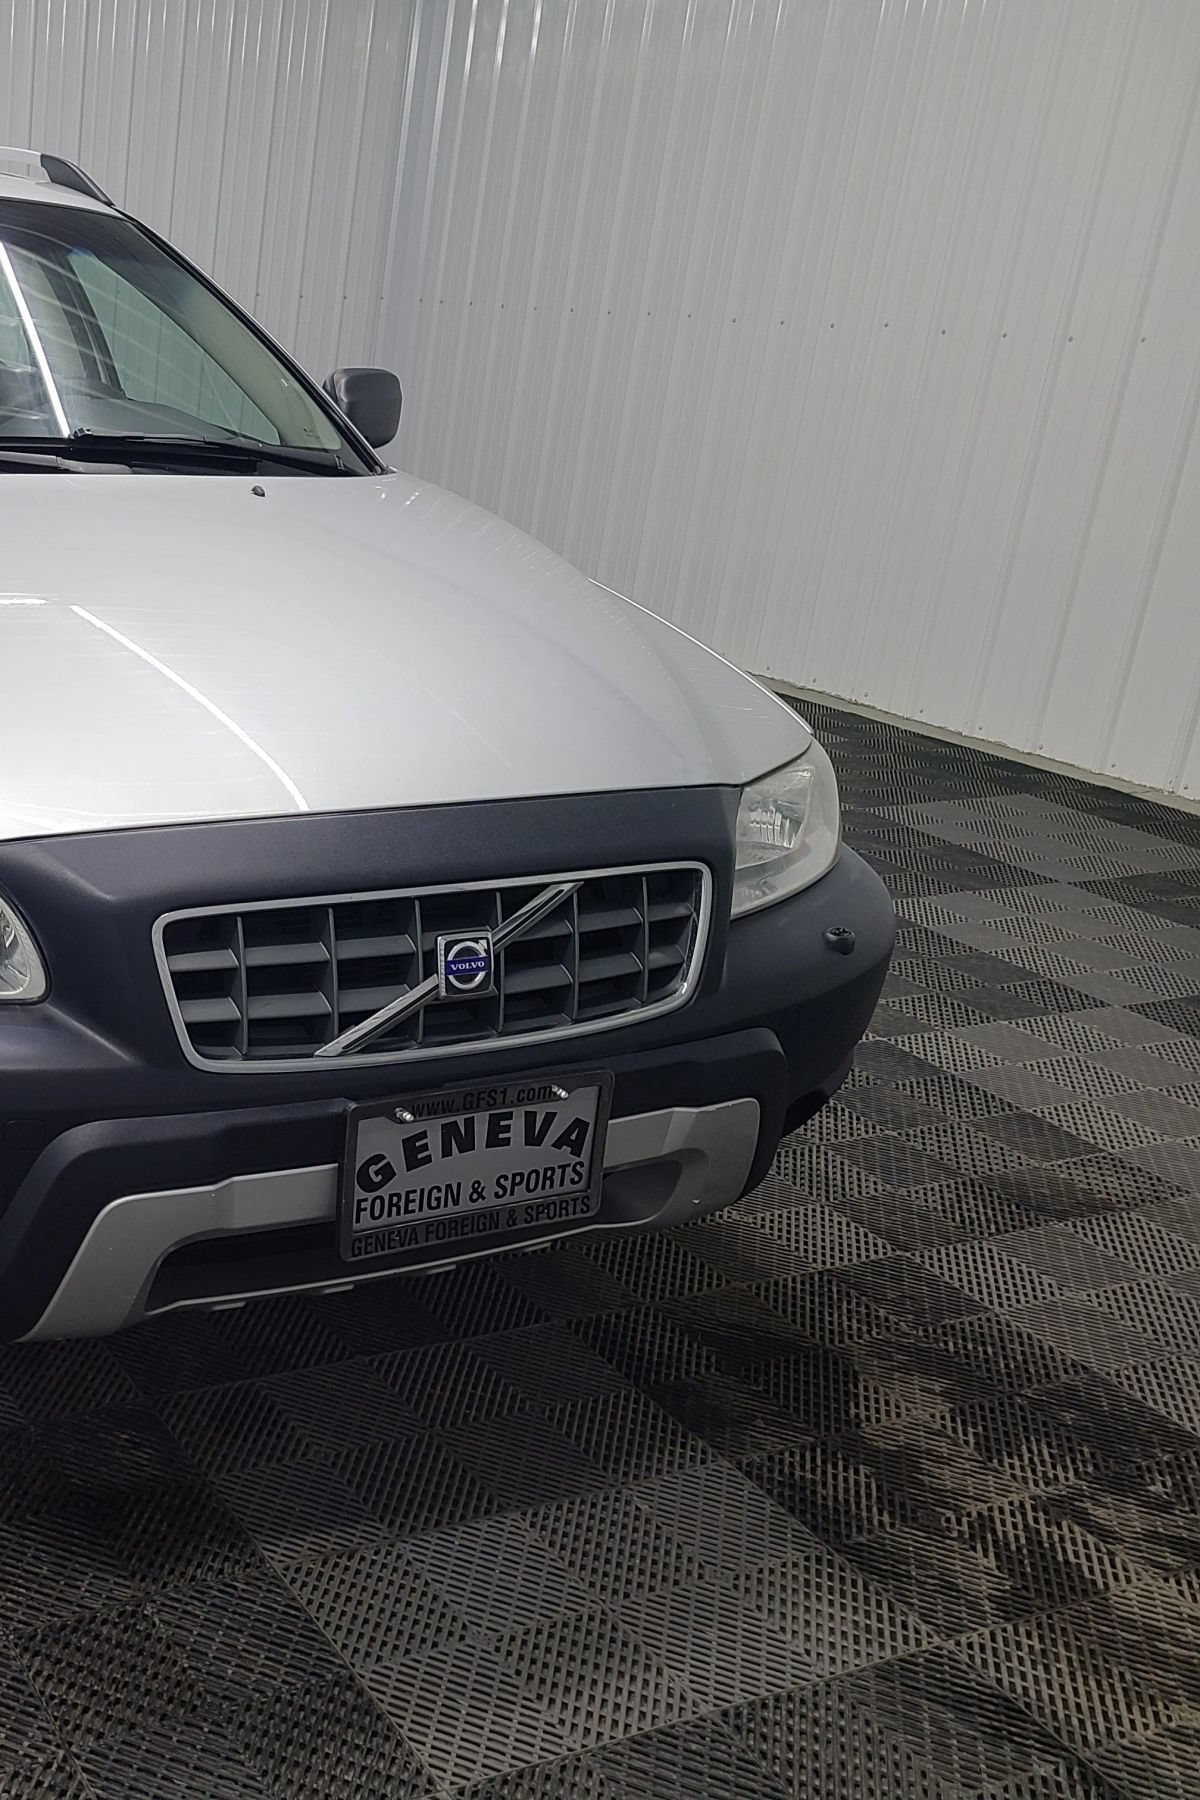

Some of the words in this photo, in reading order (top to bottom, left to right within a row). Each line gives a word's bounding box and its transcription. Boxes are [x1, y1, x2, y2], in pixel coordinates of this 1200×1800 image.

[450, 960, 485, 971] VOLVO
[411, 1084, 553, 1118] www.GFS1.com
[356, 1110, 590, 1193] GENEVA
[354, 1181, 462, 1225] FOREIGN
[469, 1180, 486, 1204] &
[494, 1161, 585, 1200] SPORTS
[351, 1228, 419, 1258] GENEVA
[425, 1211, 500, 1243] FOREIGN
[506, 1209, 518, 1228] &
[524, 1196, 591, 1225] SPORTS
